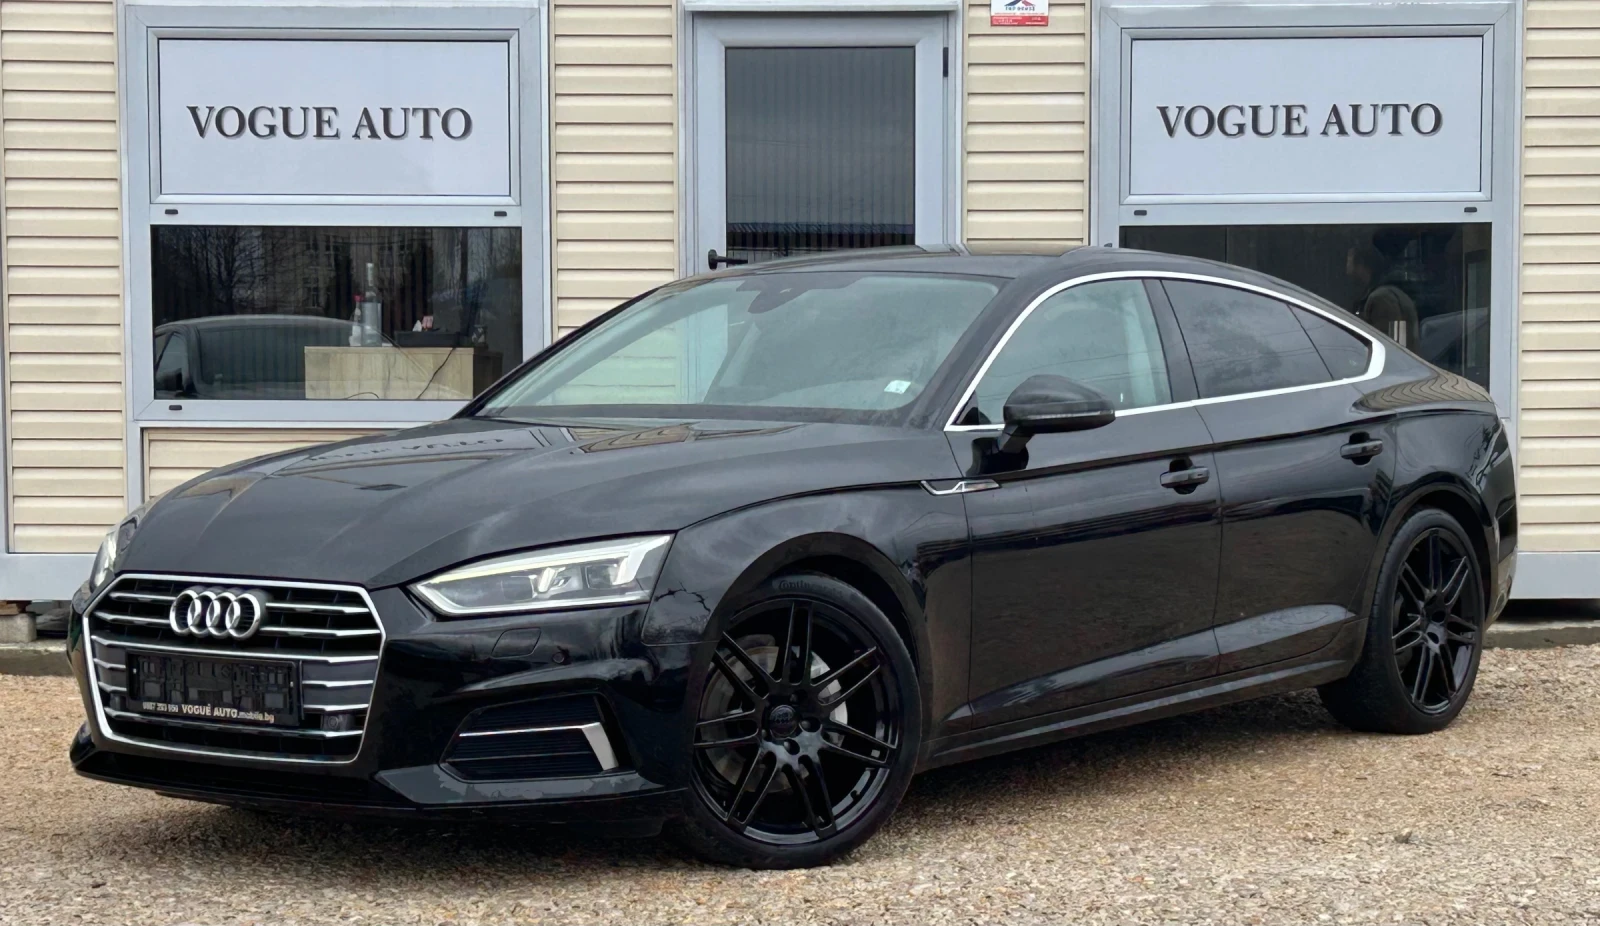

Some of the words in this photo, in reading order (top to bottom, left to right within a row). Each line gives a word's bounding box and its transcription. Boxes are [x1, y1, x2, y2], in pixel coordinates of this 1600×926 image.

[186, 106, 340, 139] VOGUE
[352, 106, 473, 140] AUTO
[1157, 104, 1309, 138] VOGUE
[1320, 103, 1443, 137] AUTO
[181, 703, 211, 716] VOGUE
